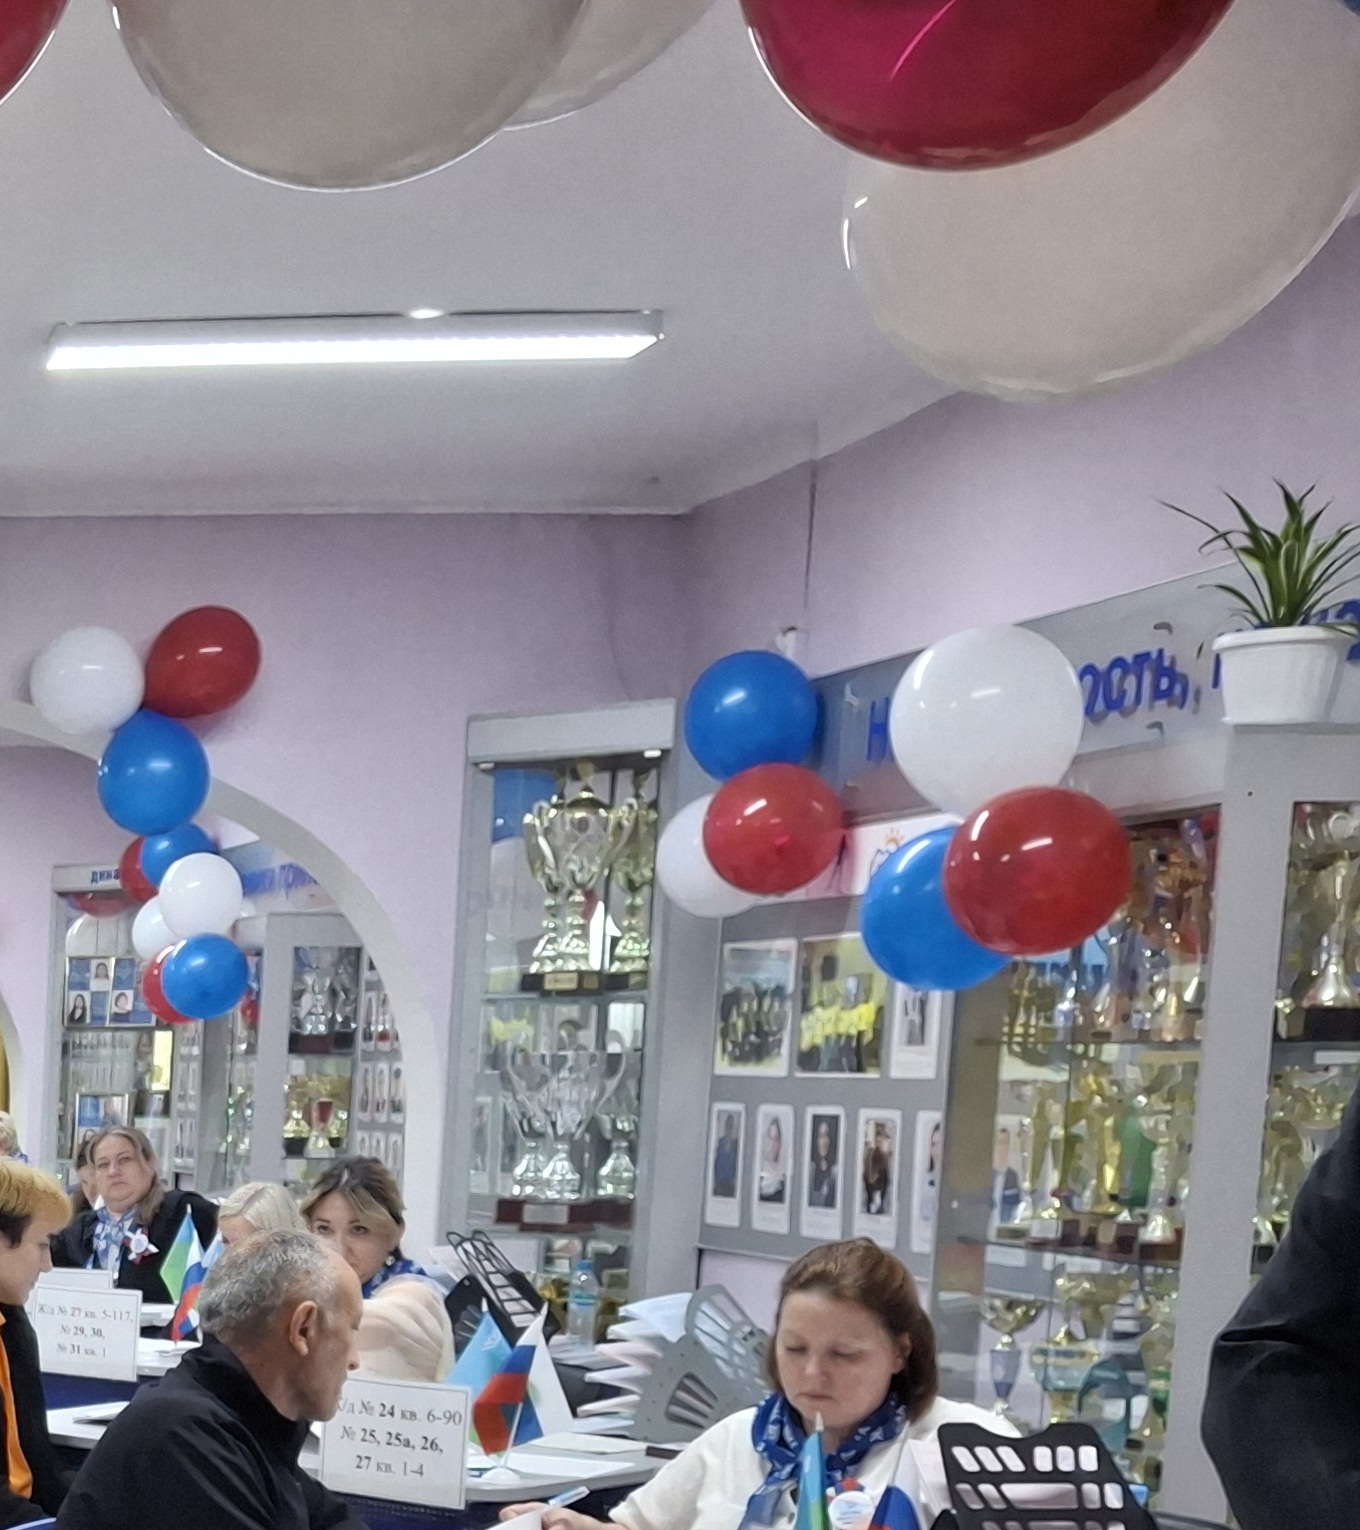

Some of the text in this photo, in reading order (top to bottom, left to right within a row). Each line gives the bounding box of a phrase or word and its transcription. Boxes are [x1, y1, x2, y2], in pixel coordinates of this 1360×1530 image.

[358, 1399, 375, 1416] №
[379, 1403, 395, 1418] 24
[427, 1409, 462, 1426] 6-90
[340, 1425, 443, 1453] № 25, 25а, 26,
[355, 1455, 372, 1470] 27
[403, 1462, 424, 1477] 1-4
